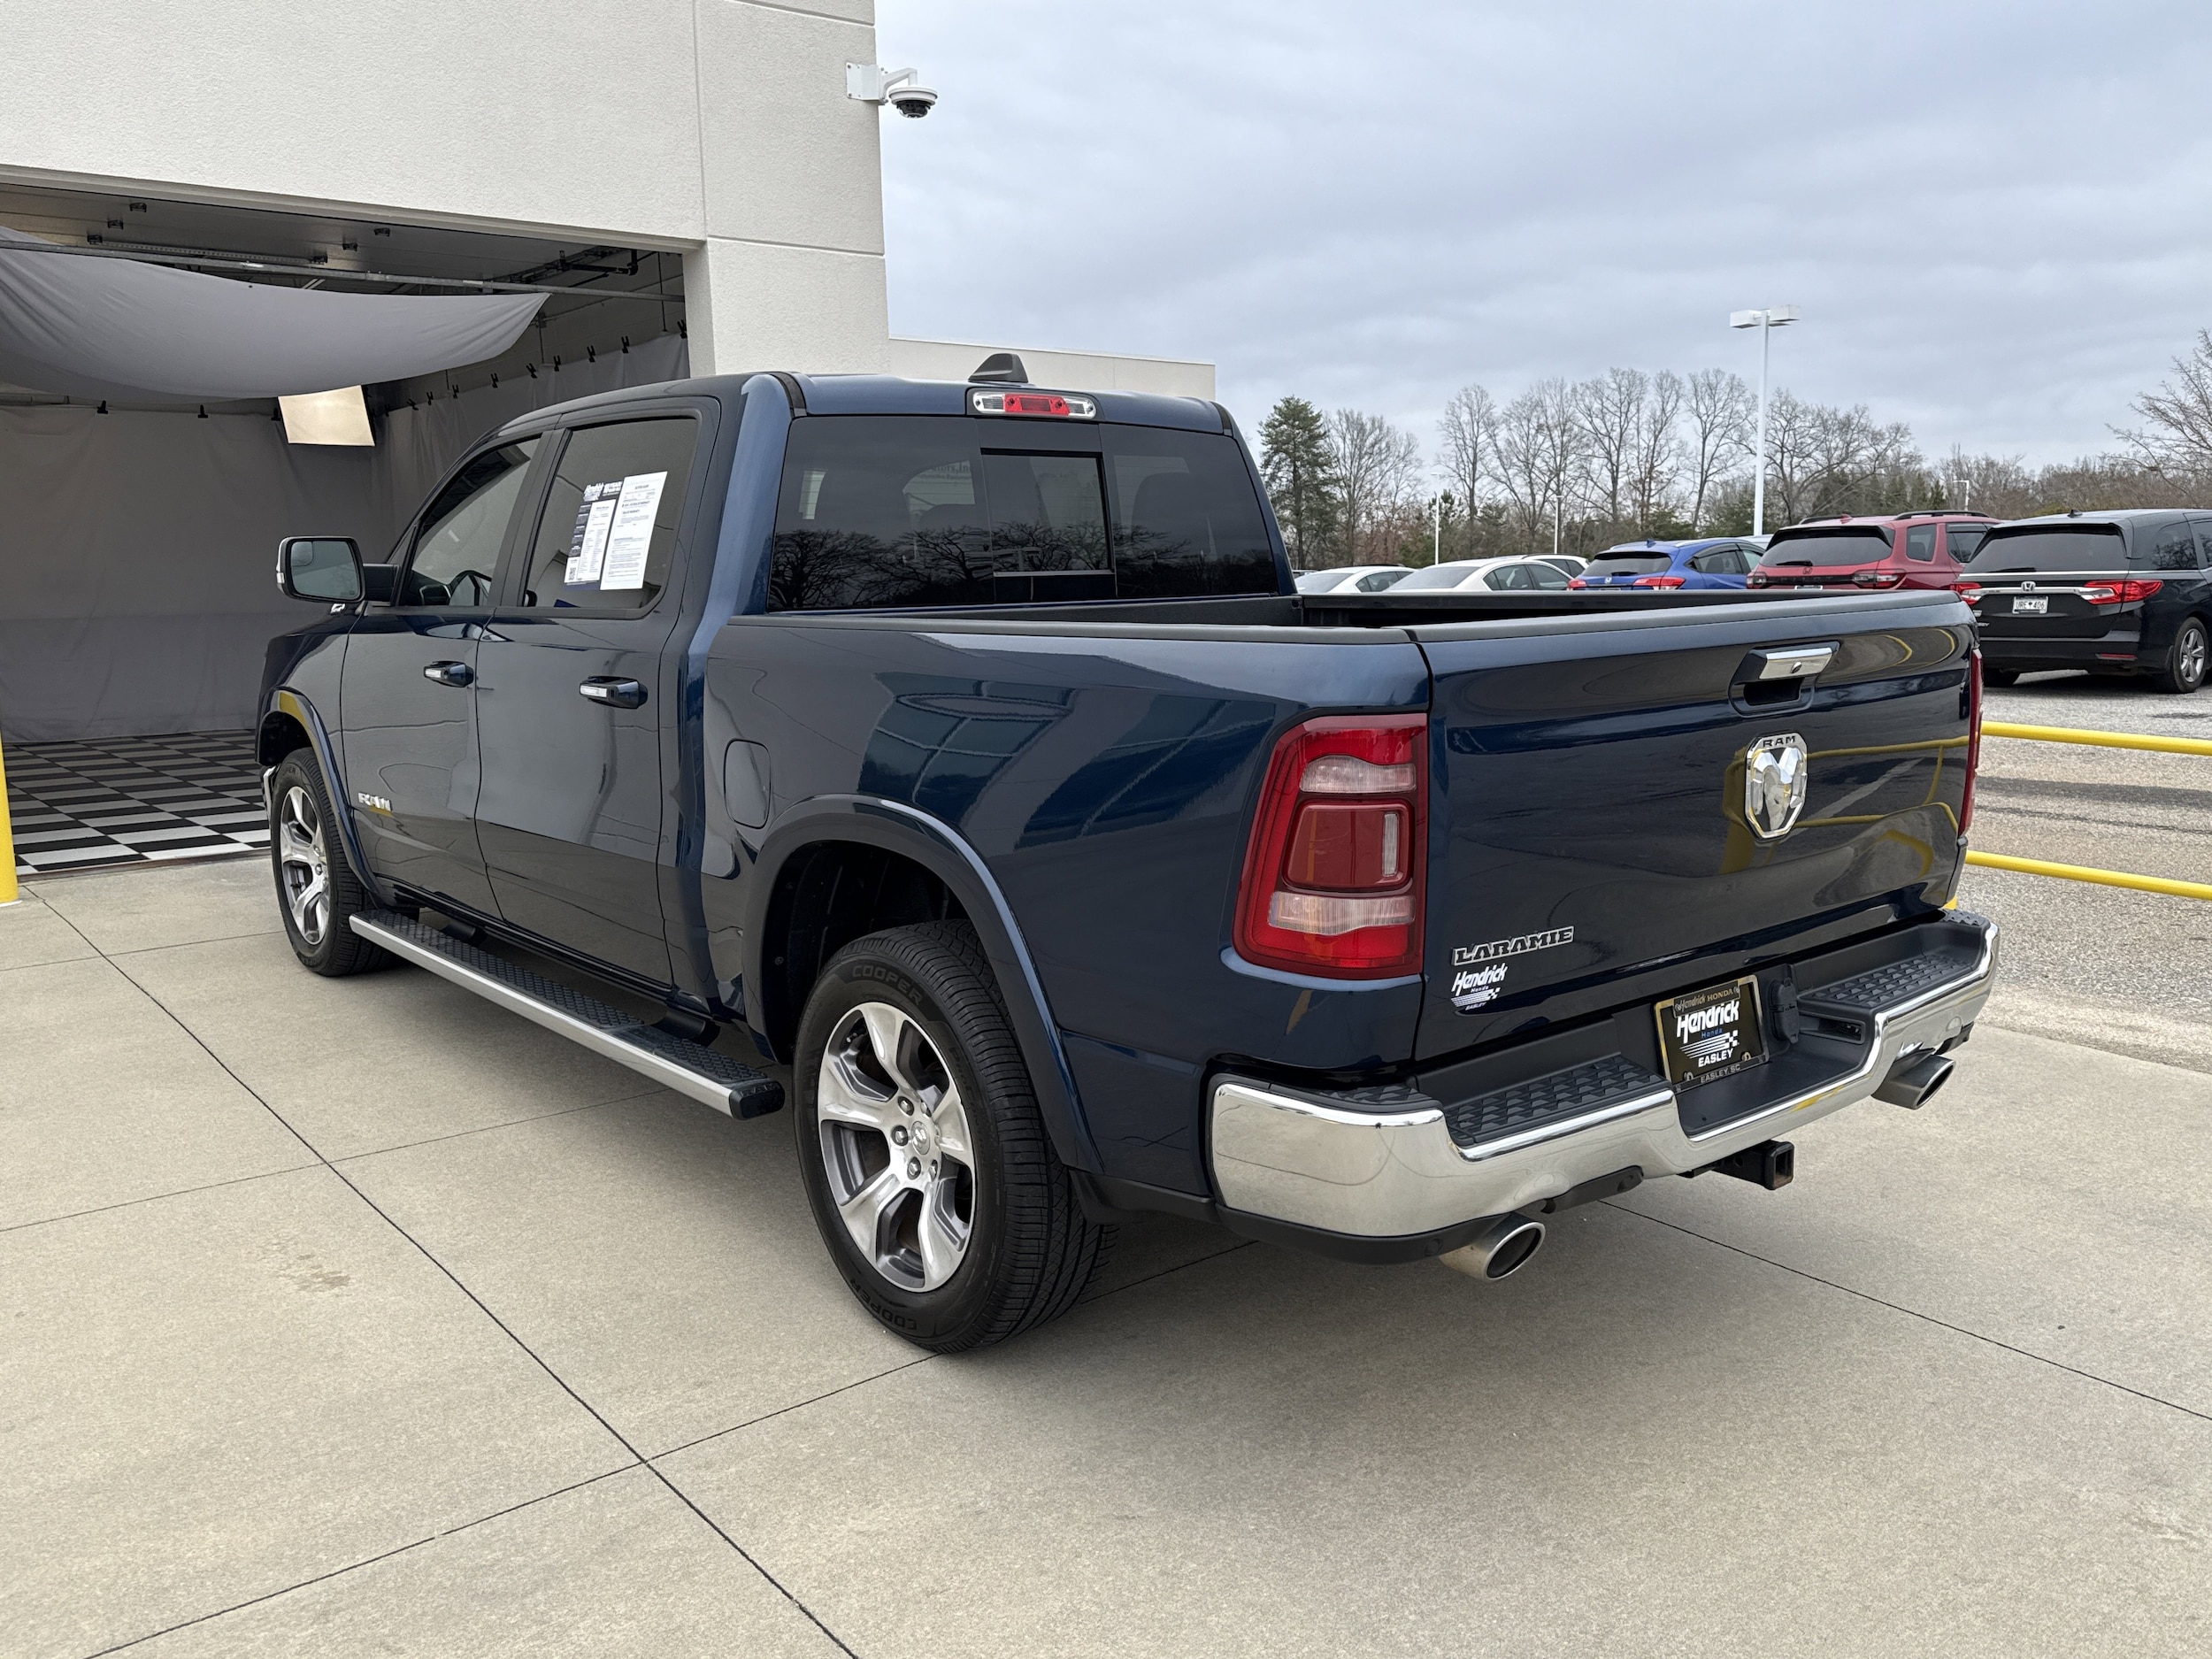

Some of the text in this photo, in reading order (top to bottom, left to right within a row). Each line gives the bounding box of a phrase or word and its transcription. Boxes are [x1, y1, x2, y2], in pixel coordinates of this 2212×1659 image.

[1763, 735, 1796, 748] RAM
[357, 792, 392, 812] RAM
[1452, 926, 1575, 966] LARAMIE
[852, 964, 924, 1007] COOPER
[1451, 963, 1508, 997] Hendrick
[1680, 988, 1733, 1012] Hendrick HONDA
[1677, 1000, 1740, 1044] Hendrick
[1701, 1027, 1723, 1039] Honda
[1698, 1048, 1734, 1068] EASLEY
[1701, 1064, 1741, 1084] EASLEY SC
[849, 1278, 918, 1331] COOPER
